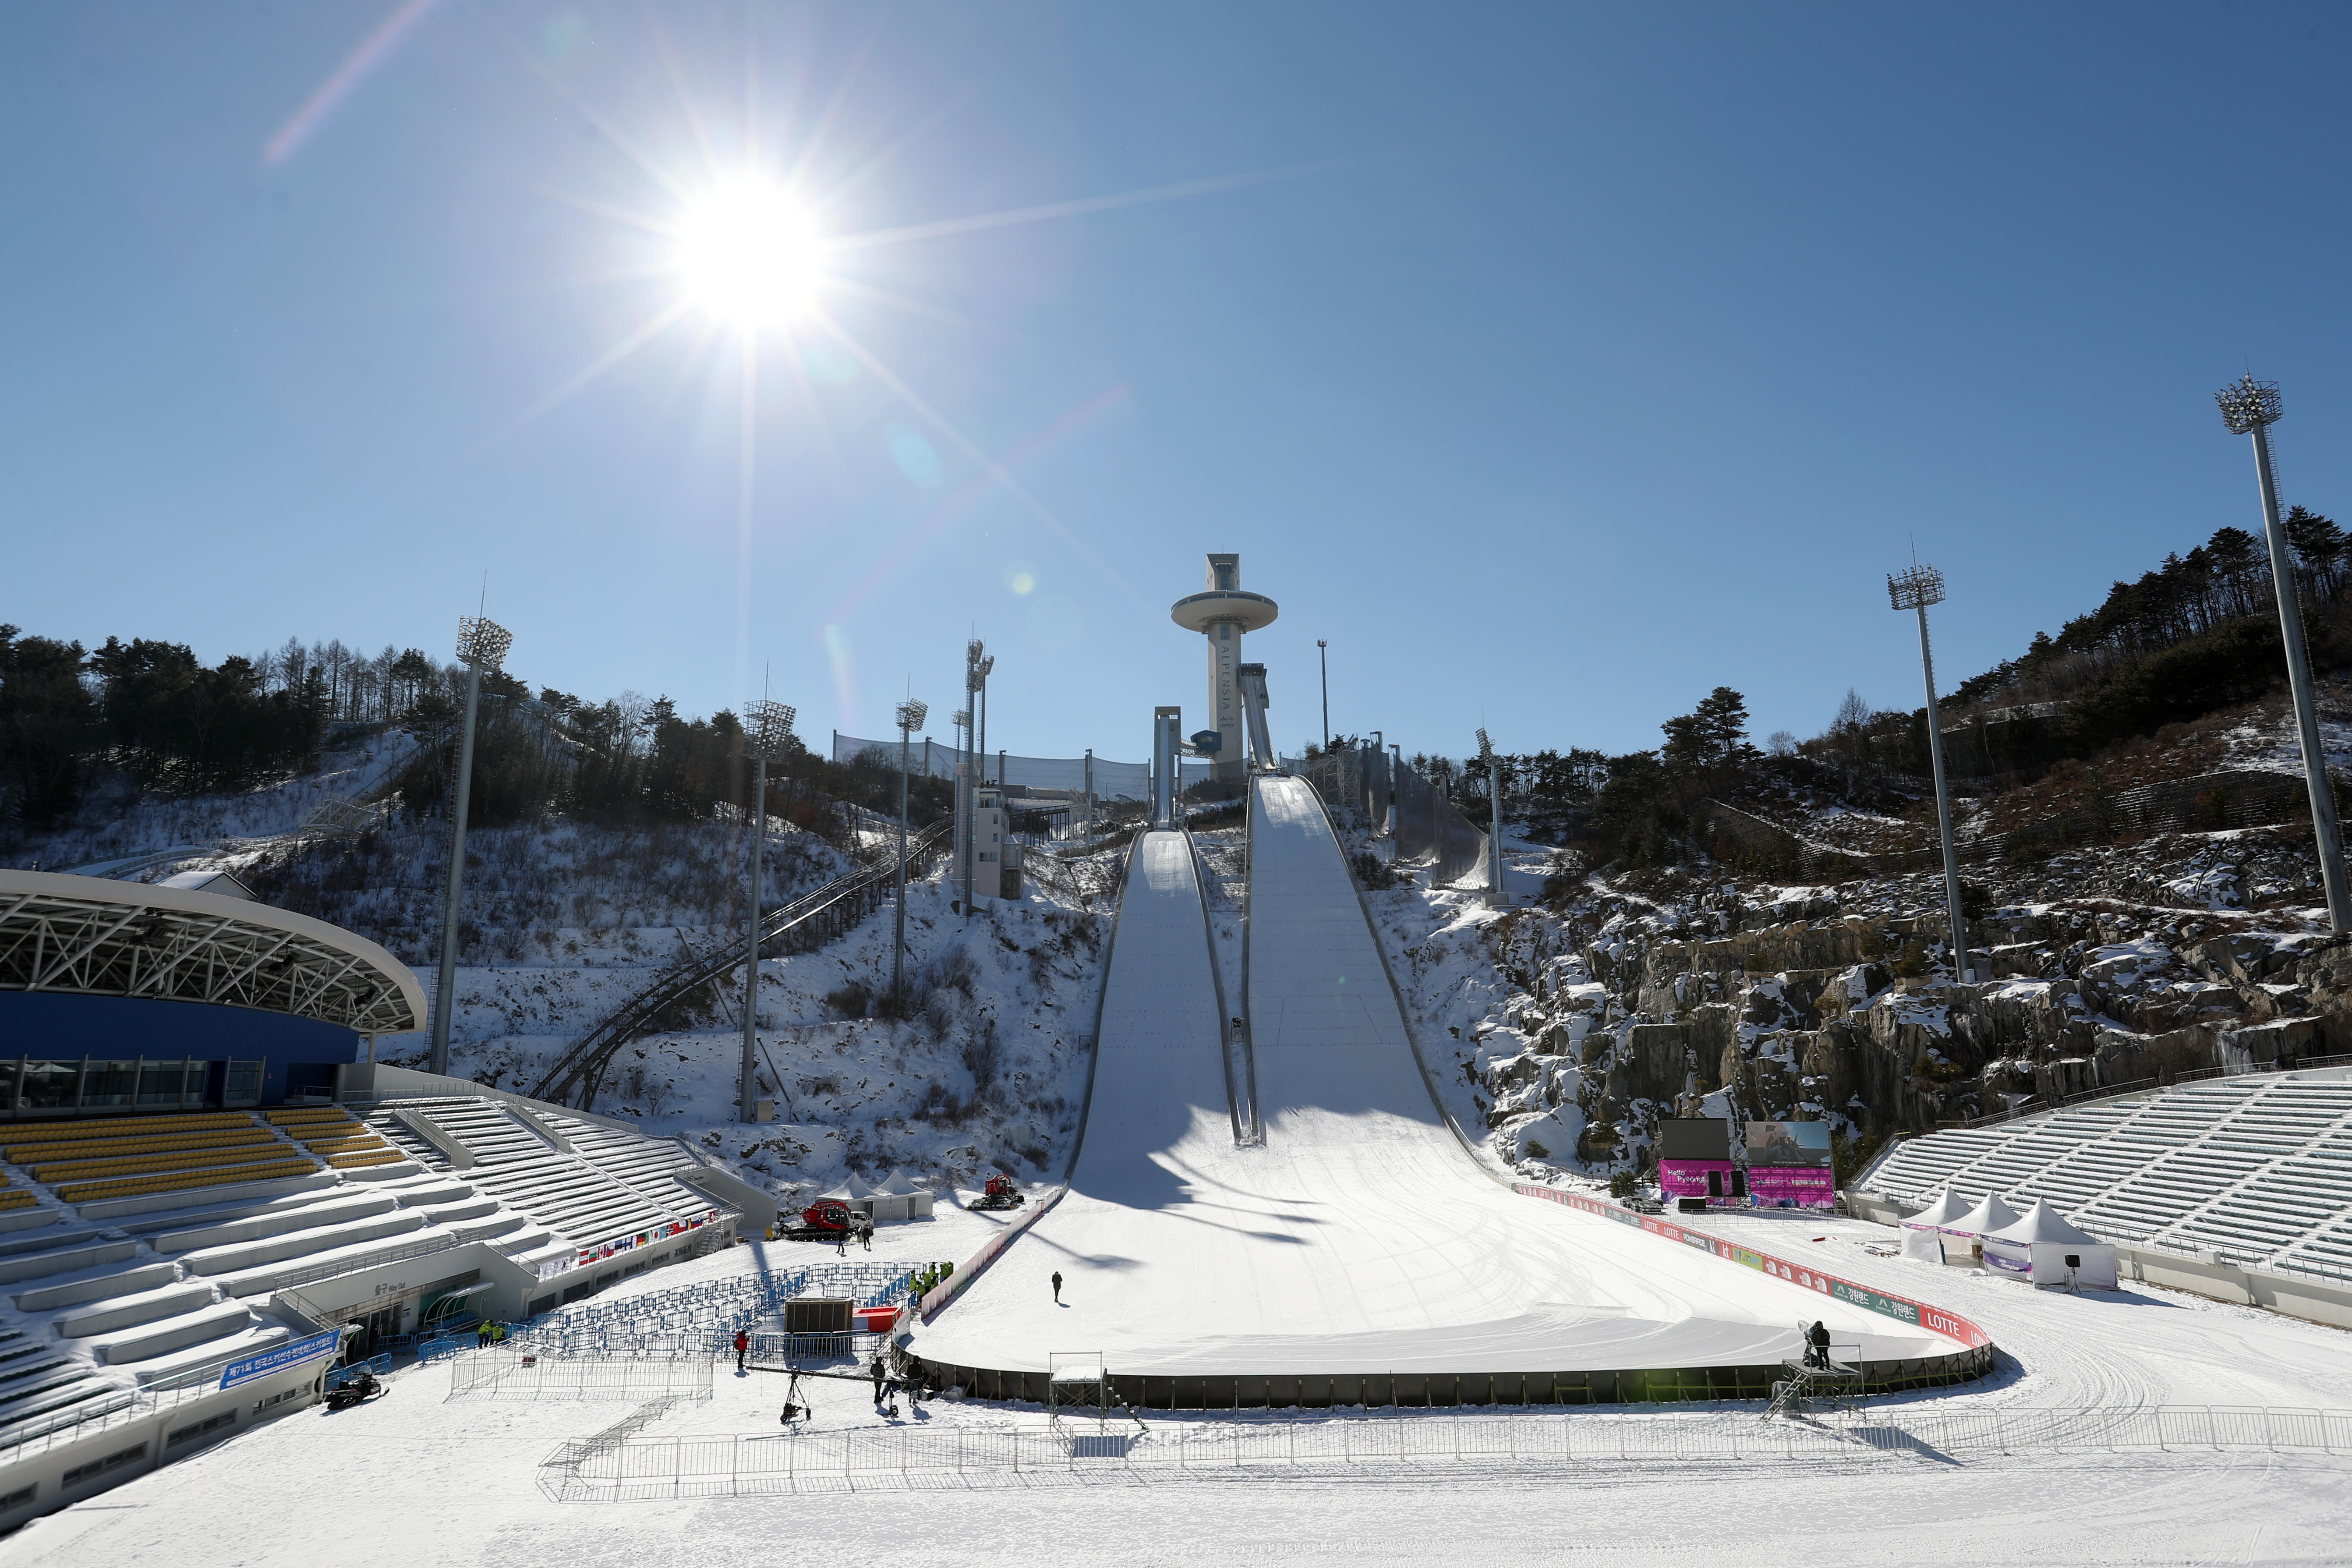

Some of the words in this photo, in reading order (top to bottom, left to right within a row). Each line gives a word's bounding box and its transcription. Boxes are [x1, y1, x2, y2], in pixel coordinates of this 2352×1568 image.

[1221, 646, 1230, 710] ALPENSIA
[1644, 1220, 1658, 1232] LOTTE
[1664, 1226, 1679, 1239] LOTTE
[1683, 1233, 1706, 1247] POWERADE
[1722, 1244, 1730, 1258] kt
[1848, 1288, 1869, 1305] 강원랜드
[1891, 1302, 1916, 1320] 강원랜드
[1927, 1312, 1960, 1337] LOTTE
[229, 1362, 252, 1377] 제71회
